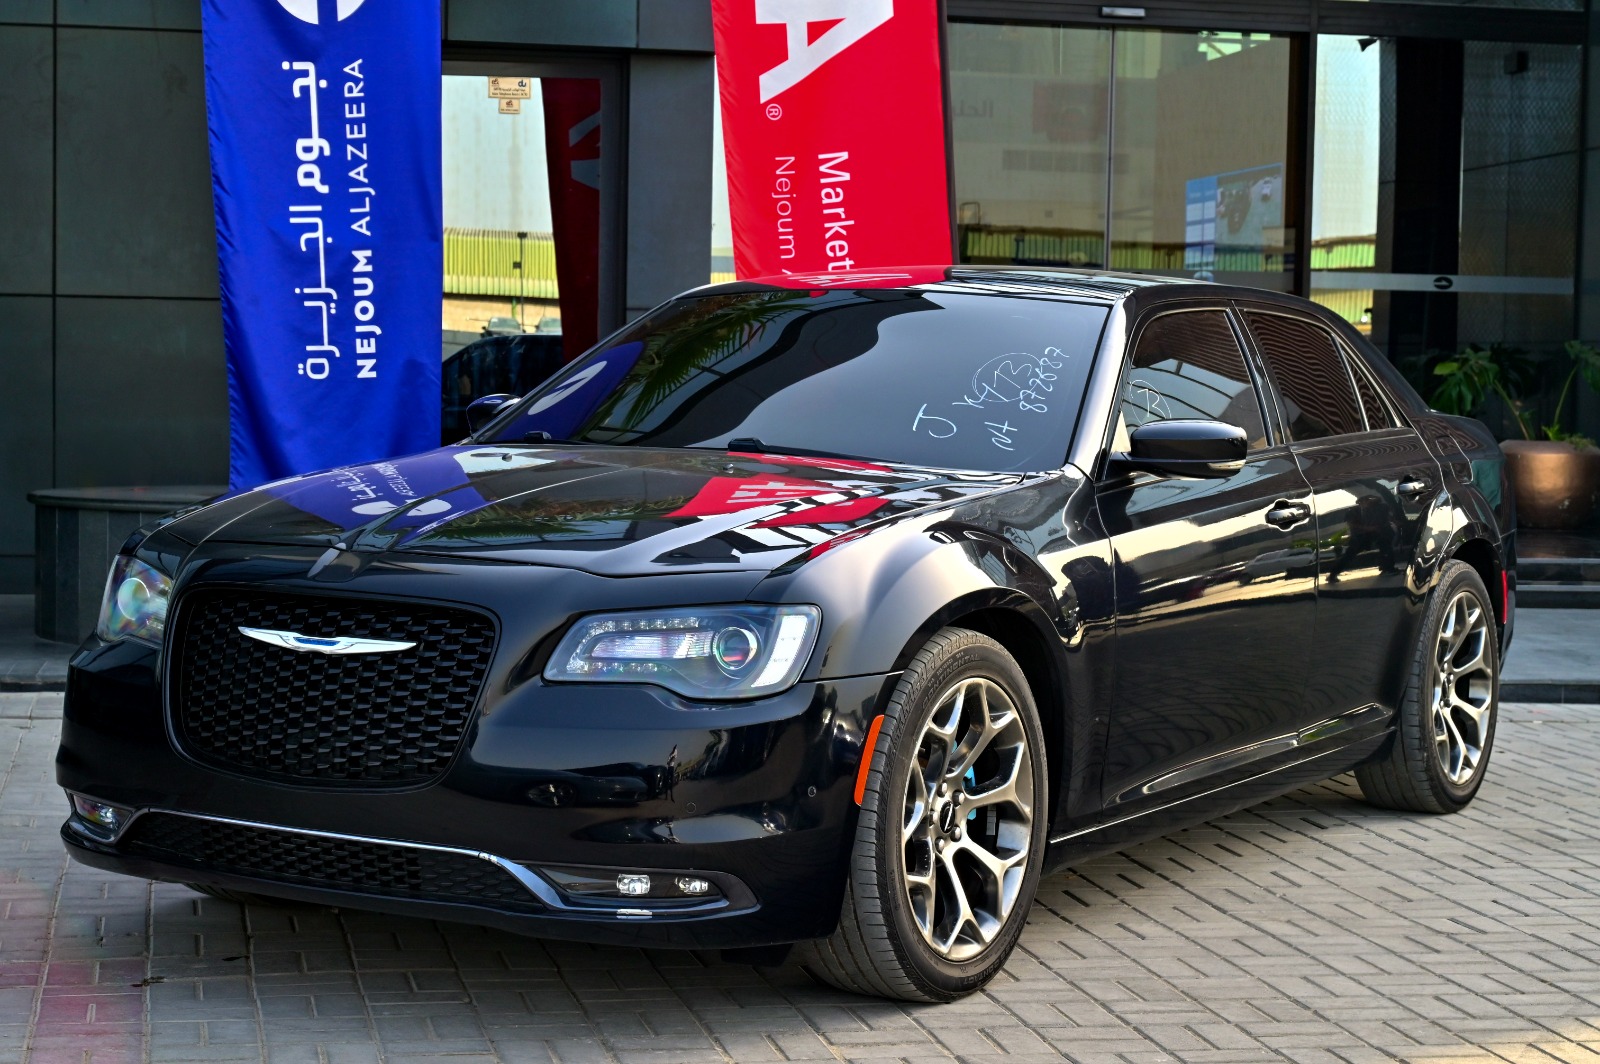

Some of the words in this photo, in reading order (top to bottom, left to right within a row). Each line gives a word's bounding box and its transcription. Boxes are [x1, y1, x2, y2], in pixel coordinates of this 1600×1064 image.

[281, 61, 331, 194] نجوم
[342, 58, 376, 237] ALJAZEERA
[771, 156, 796, 259] Nejoum
[818, 151, 855, 271] Market
[288, 205, 341, 380] الجزيرة
[351, 249, 382, 379] NEJOUM
